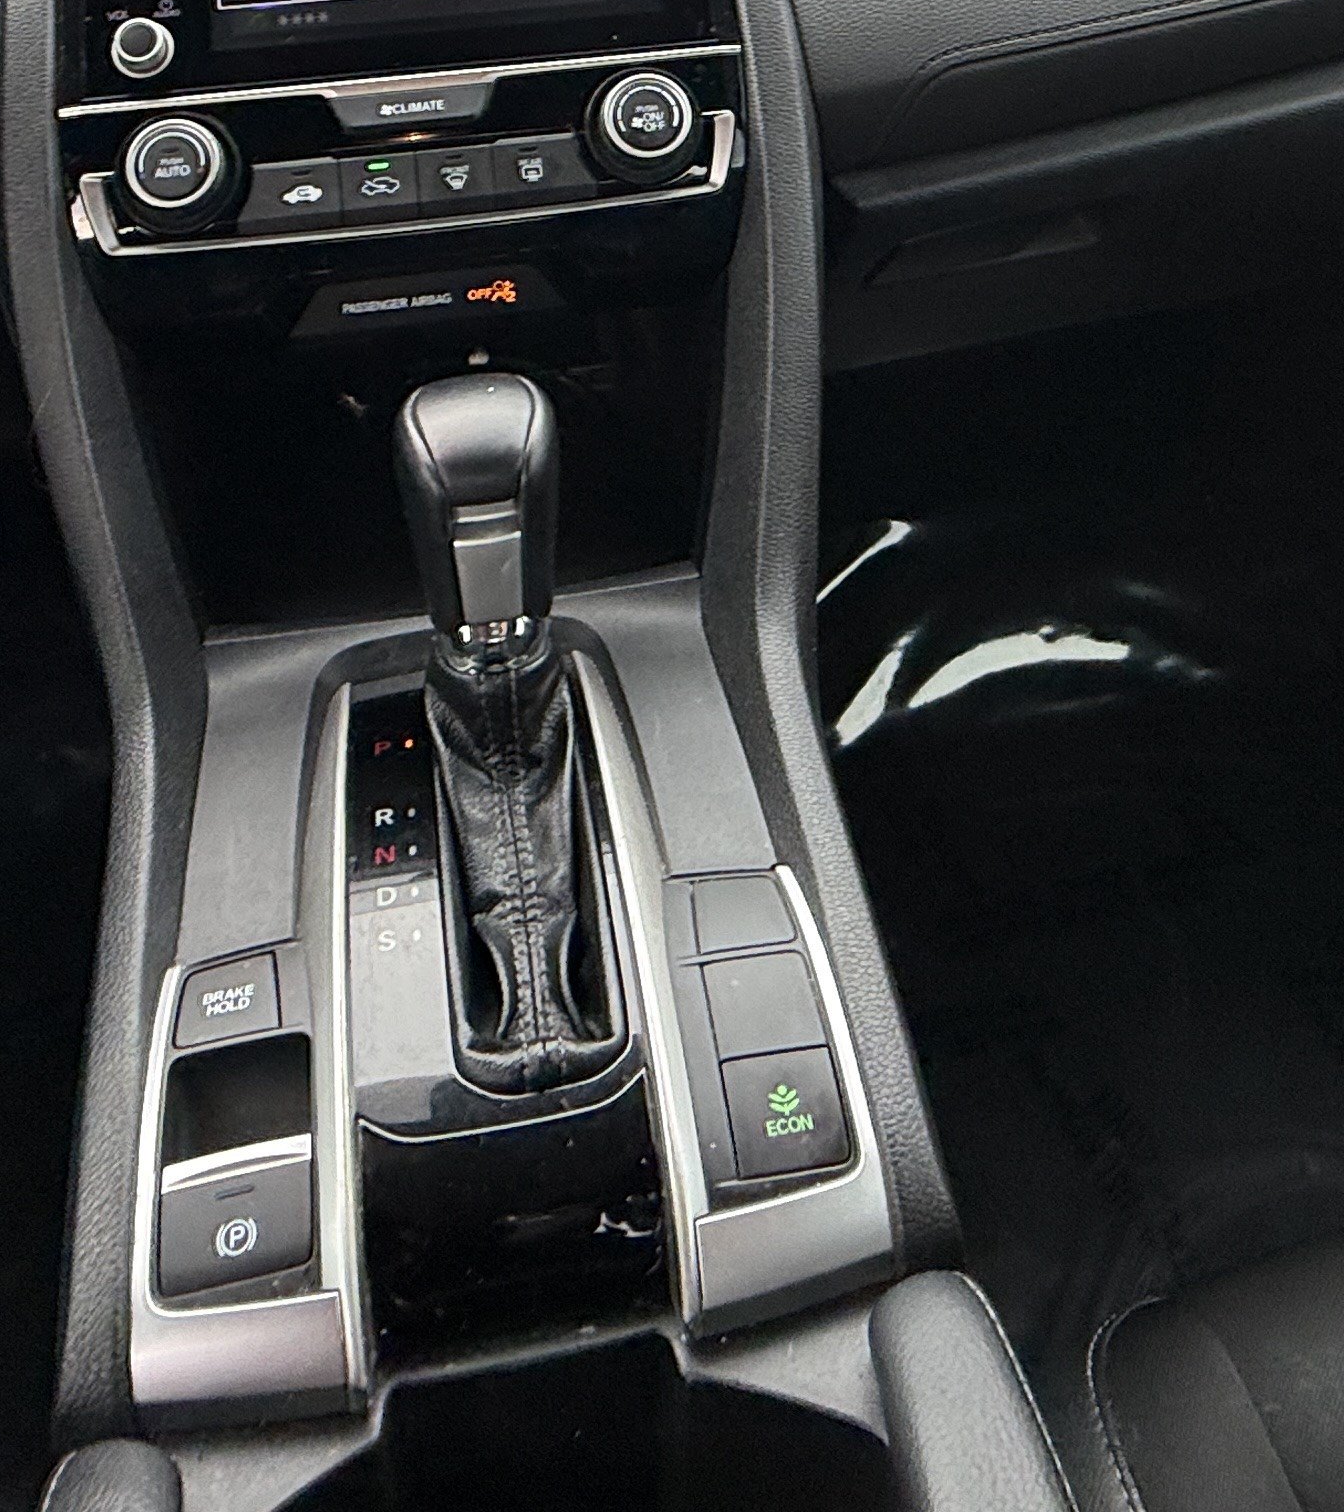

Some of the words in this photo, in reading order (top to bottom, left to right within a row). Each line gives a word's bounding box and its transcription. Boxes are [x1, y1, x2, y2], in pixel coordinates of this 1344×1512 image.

[393, 99, 445, 115] CLIMATE
[155, 165, 191, 178] AUTO
[411, 293, 453, 307] AIRBAG
[467, 288, 494, 301] OFF
[374, 741, 391, 756] P
[374, 808, 394, 827] R
[374, 845, 397, 865] N
[376, 886, 398, 907] D
[378, 929, 396, 952] S
[202, 983, 256, 1005] BRAKE
[205, 996, 251, 1017] HOLD
[766, 1113, 814, 1137] ECON
